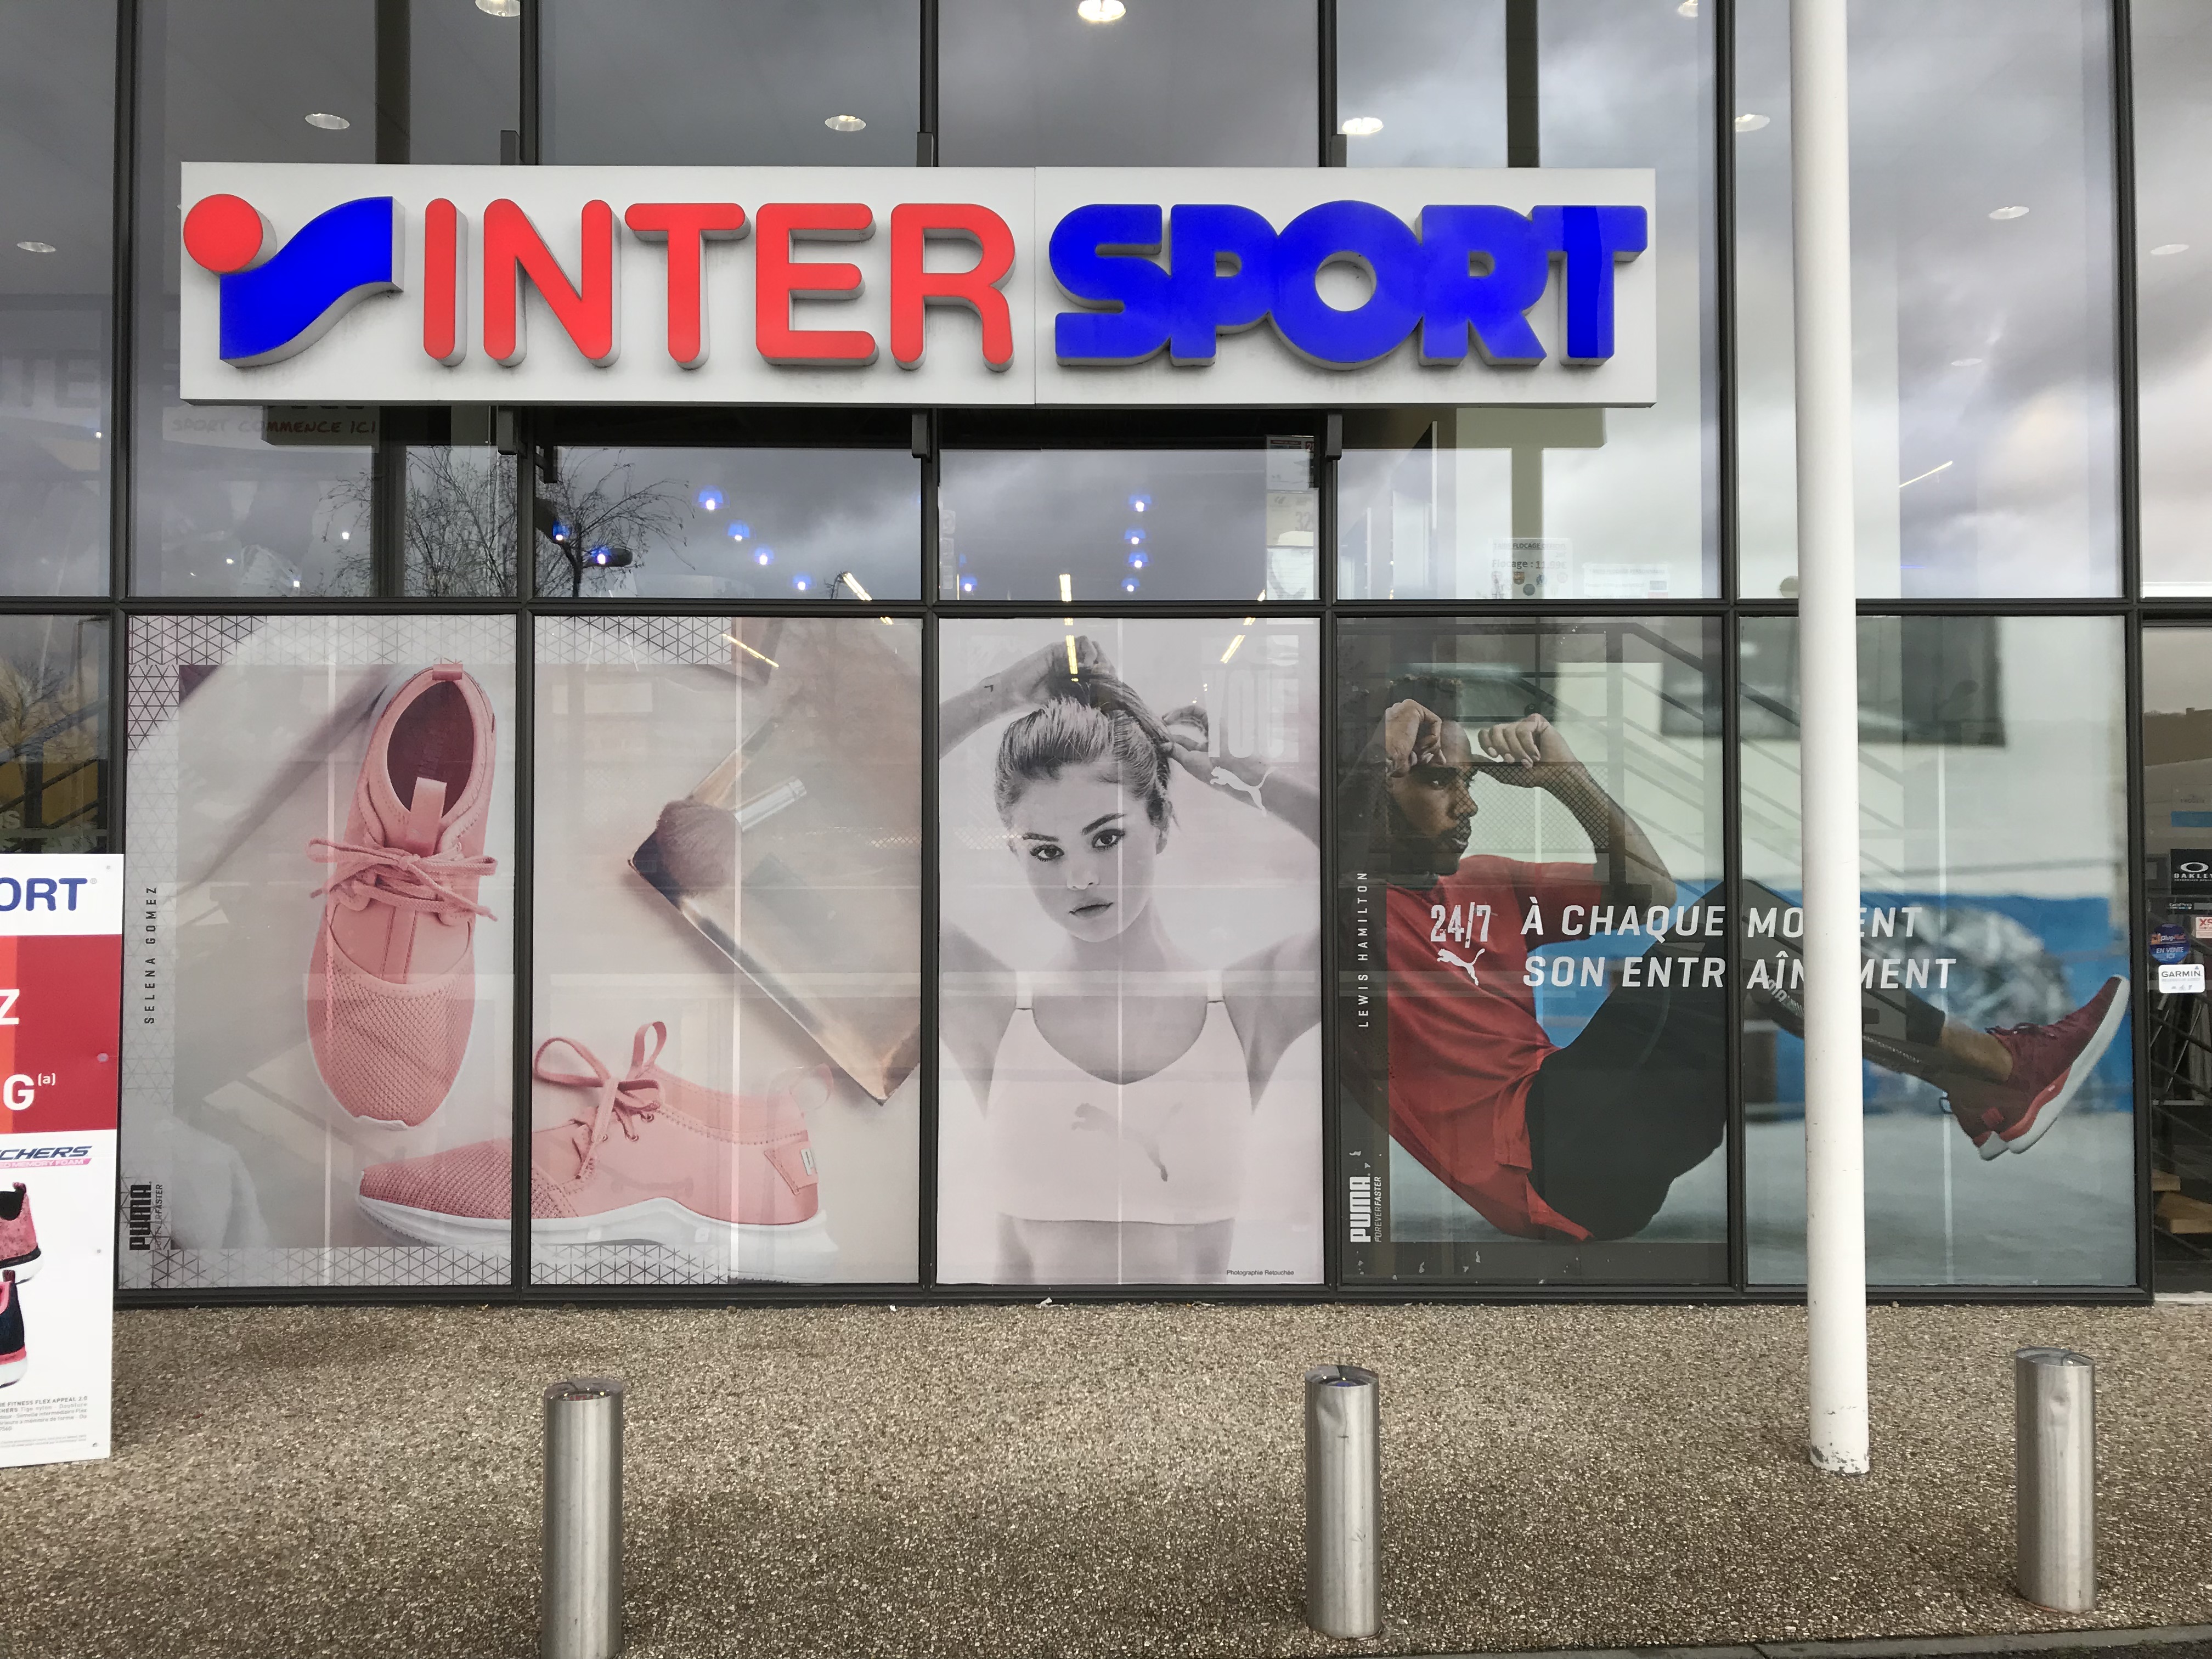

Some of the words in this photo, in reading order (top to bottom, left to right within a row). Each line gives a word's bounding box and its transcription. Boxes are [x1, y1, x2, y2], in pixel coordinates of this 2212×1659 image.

[350, 420, 376, 433] ICI
[1492, 560, 1528, 569] Flocage
[0, 877, 88, 911] ORT
[145, 887, 157, 945] GOMEZ
[1357, 873, 1368, 961] HAMILTON
[1430, 901, 1491, 948] 24/7
[1520, 896, 1544, 935] À
[1561, 905, 1726, 944] CHAQUE
[1747, 907, 1922, 938] MONT
[144, 958, 156, 1024] SELENA
[1523, 956, 1605, 988] SON
[1358, 974, 1369, 1027] LEWIS
[129, 1184, 151, 1250] PUMA
[1350, 1176, 1371, 1242] PUMA
